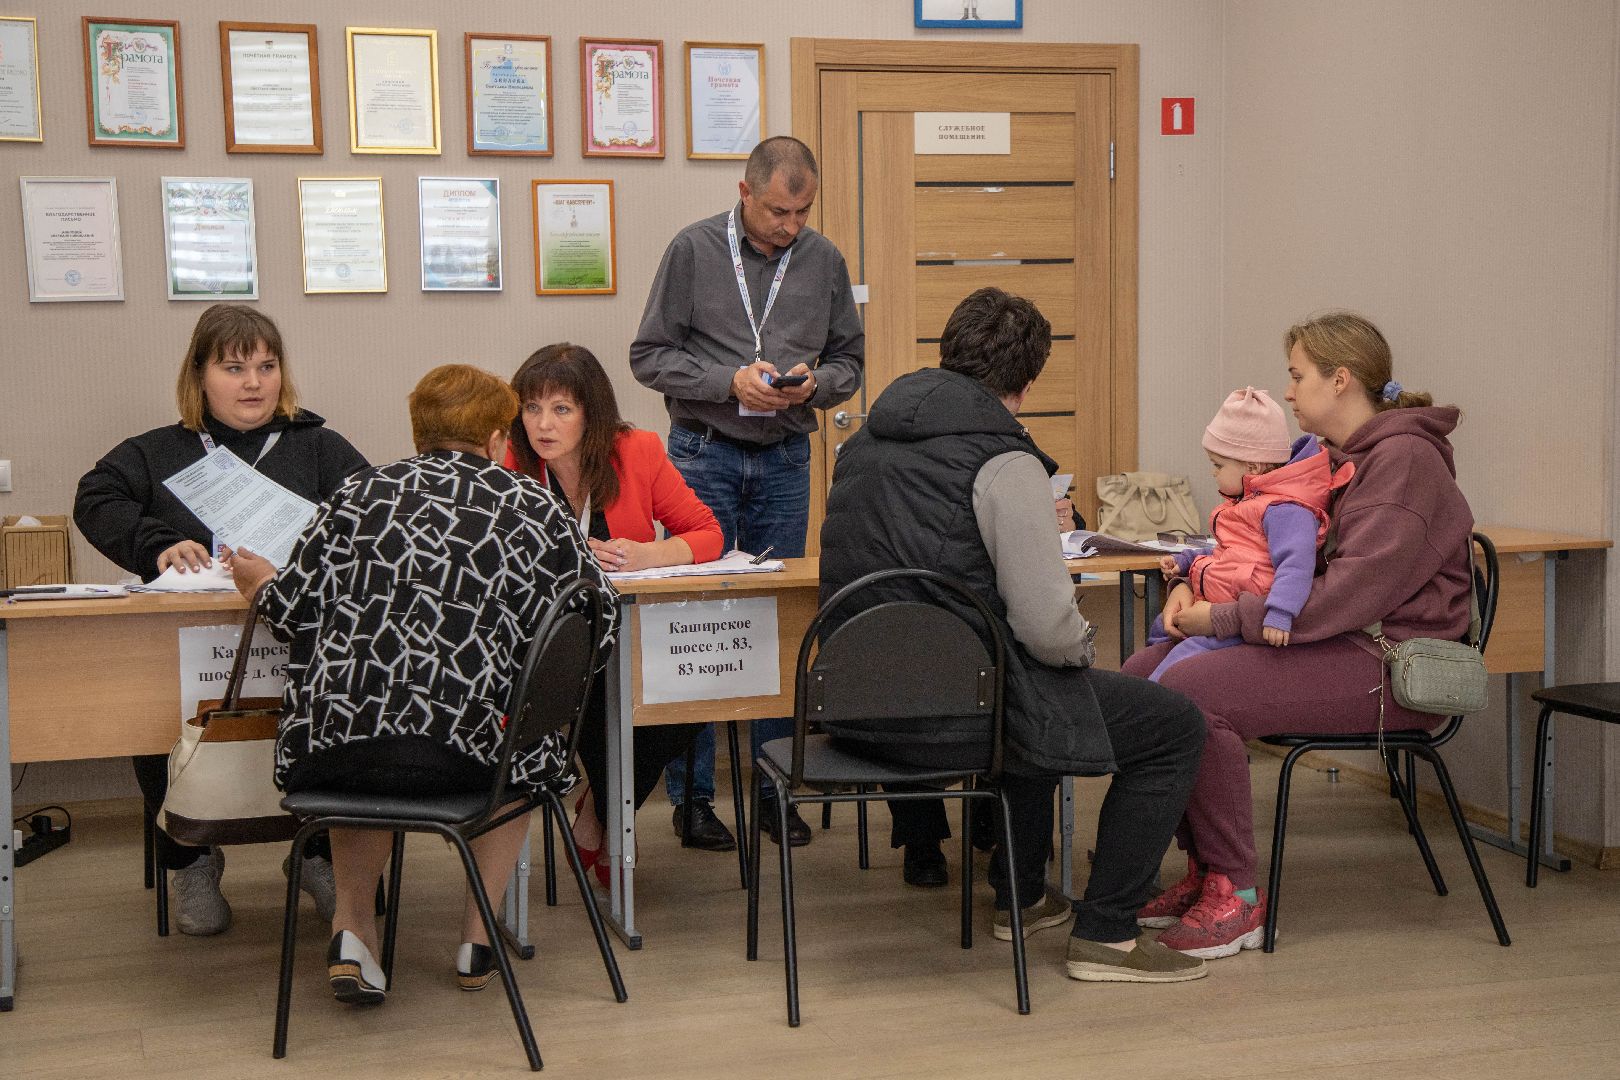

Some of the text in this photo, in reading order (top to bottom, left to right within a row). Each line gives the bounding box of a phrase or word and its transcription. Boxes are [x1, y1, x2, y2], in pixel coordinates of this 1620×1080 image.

[669, 619, 751, 635] Каширское
[211, 645, 289, 660] Каирск
[670, 637, 753, 655] шоссе д. 83,
[199, 669, 247, 682] шосе
[252, 668, 266, 680] д.
[678, 659, 743, 677] 83 корп.1
